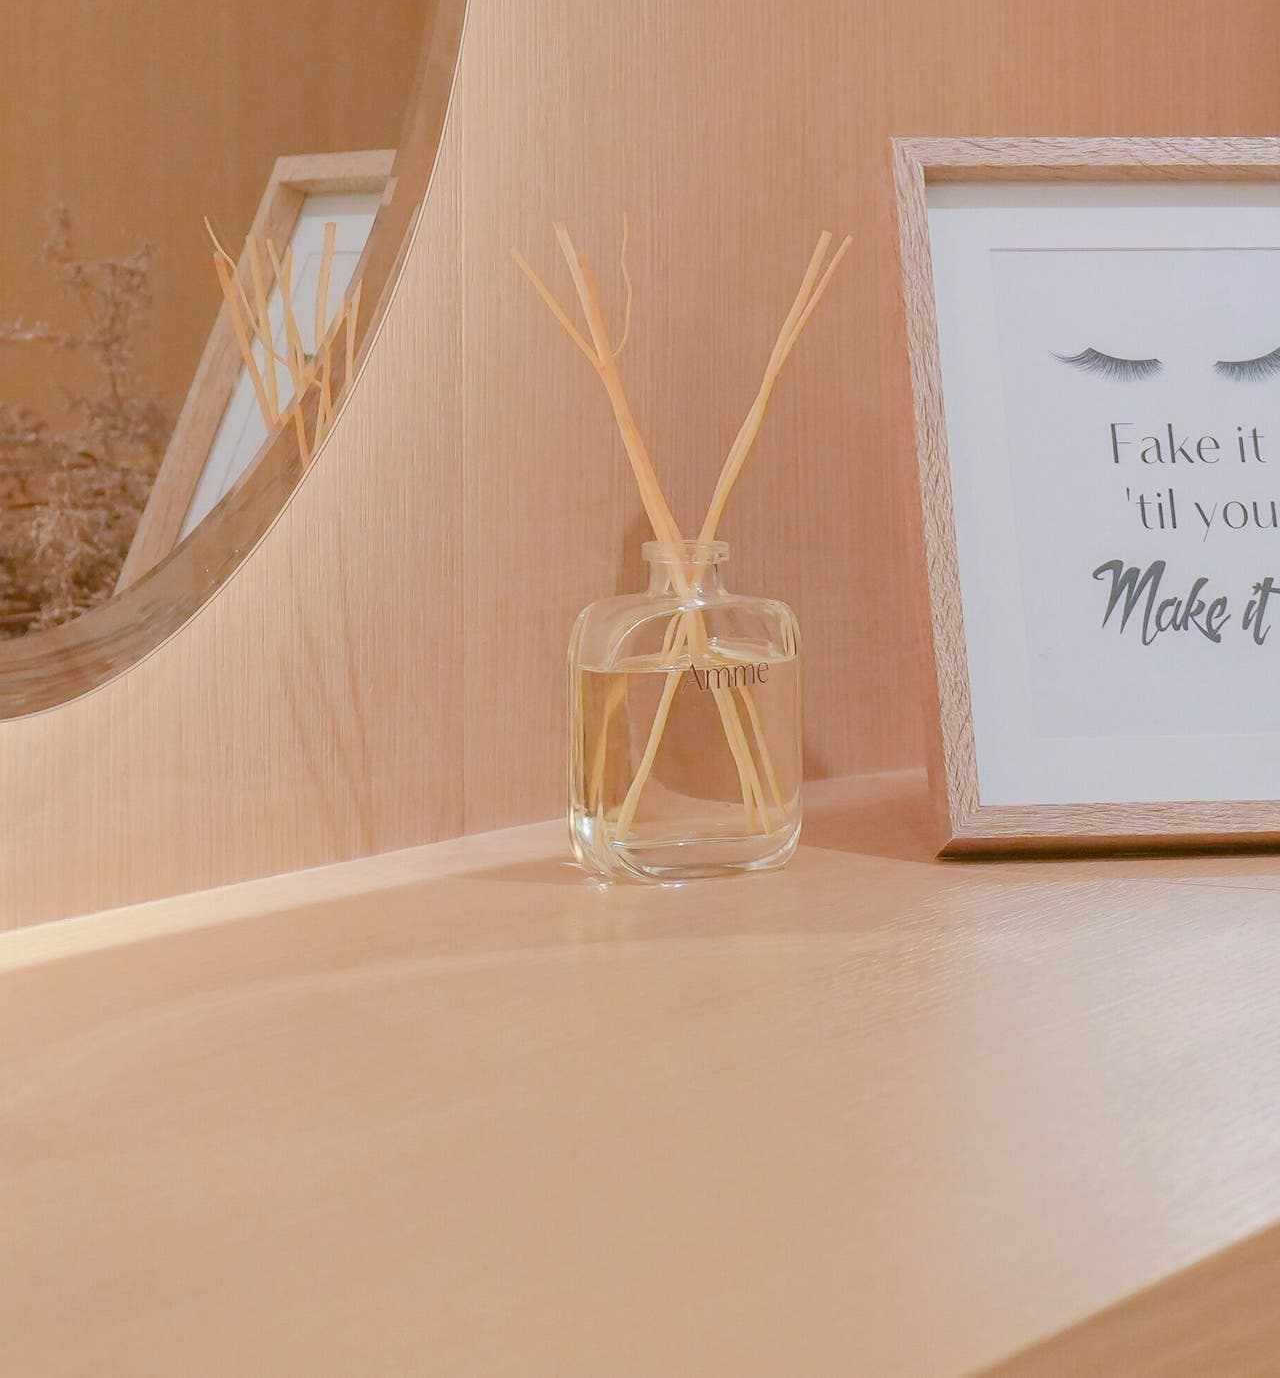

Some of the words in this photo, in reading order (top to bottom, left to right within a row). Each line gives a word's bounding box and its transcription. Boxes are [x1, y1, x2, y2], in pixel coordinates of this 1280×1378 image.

[1110, 422, 1221, 465] Fake
[1236, 425, 1269, 464] it
[1125, 486, 1178, 530] 'til
[1194, 500, 1278, 543] you
[1091, 559, 1232, 646] Make
[682, 661, 769, 692] Amme
